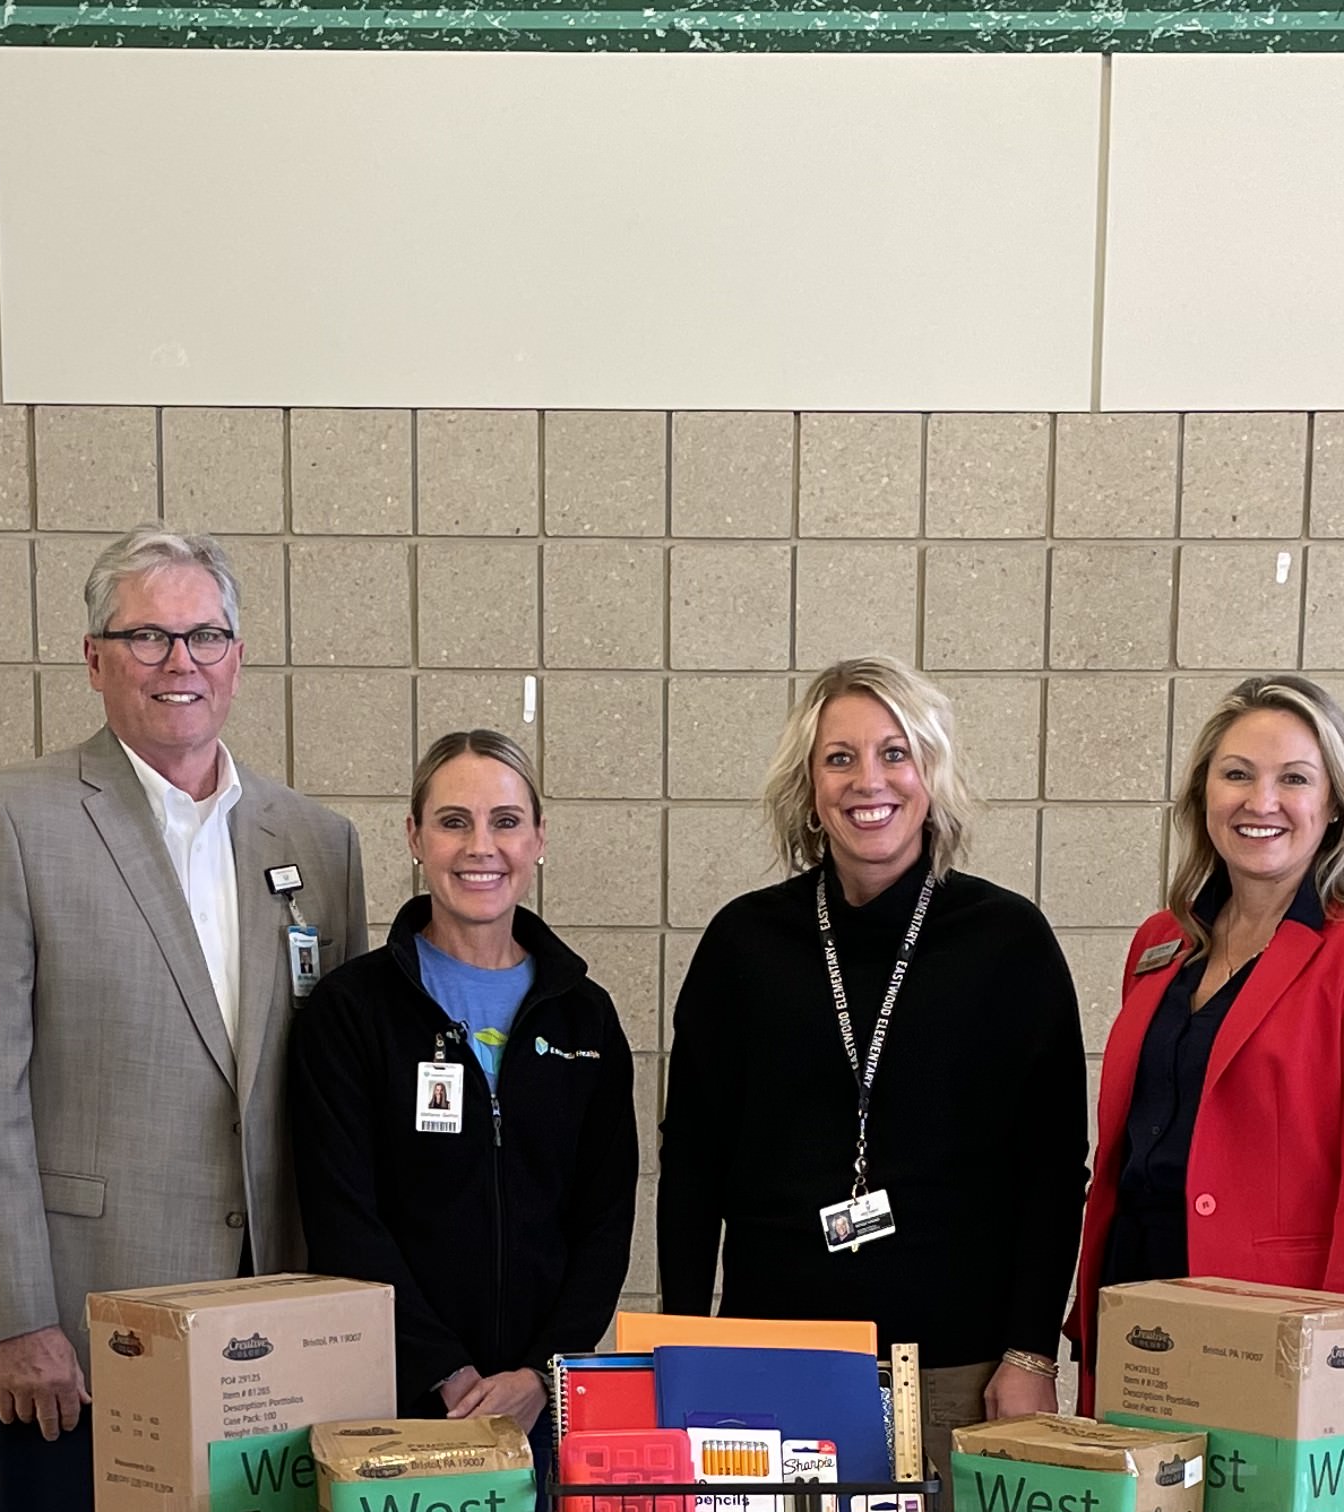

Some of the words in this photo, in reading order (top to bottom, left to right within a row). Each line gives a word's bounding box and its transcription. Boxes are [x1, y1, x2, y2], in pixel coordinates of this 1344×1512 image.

[824, 946, 848, 1010] ELEMENTARY
[880, 960, 908, 1016] EASTWOOD
[838, 1011, 860, 1071] EASTWOOD
[862, 1018, 889, 1088] ELEMENTARY
[783, 1456, 835, 1476] Sharpie
[695, 1493, 750, 1506] pencils
